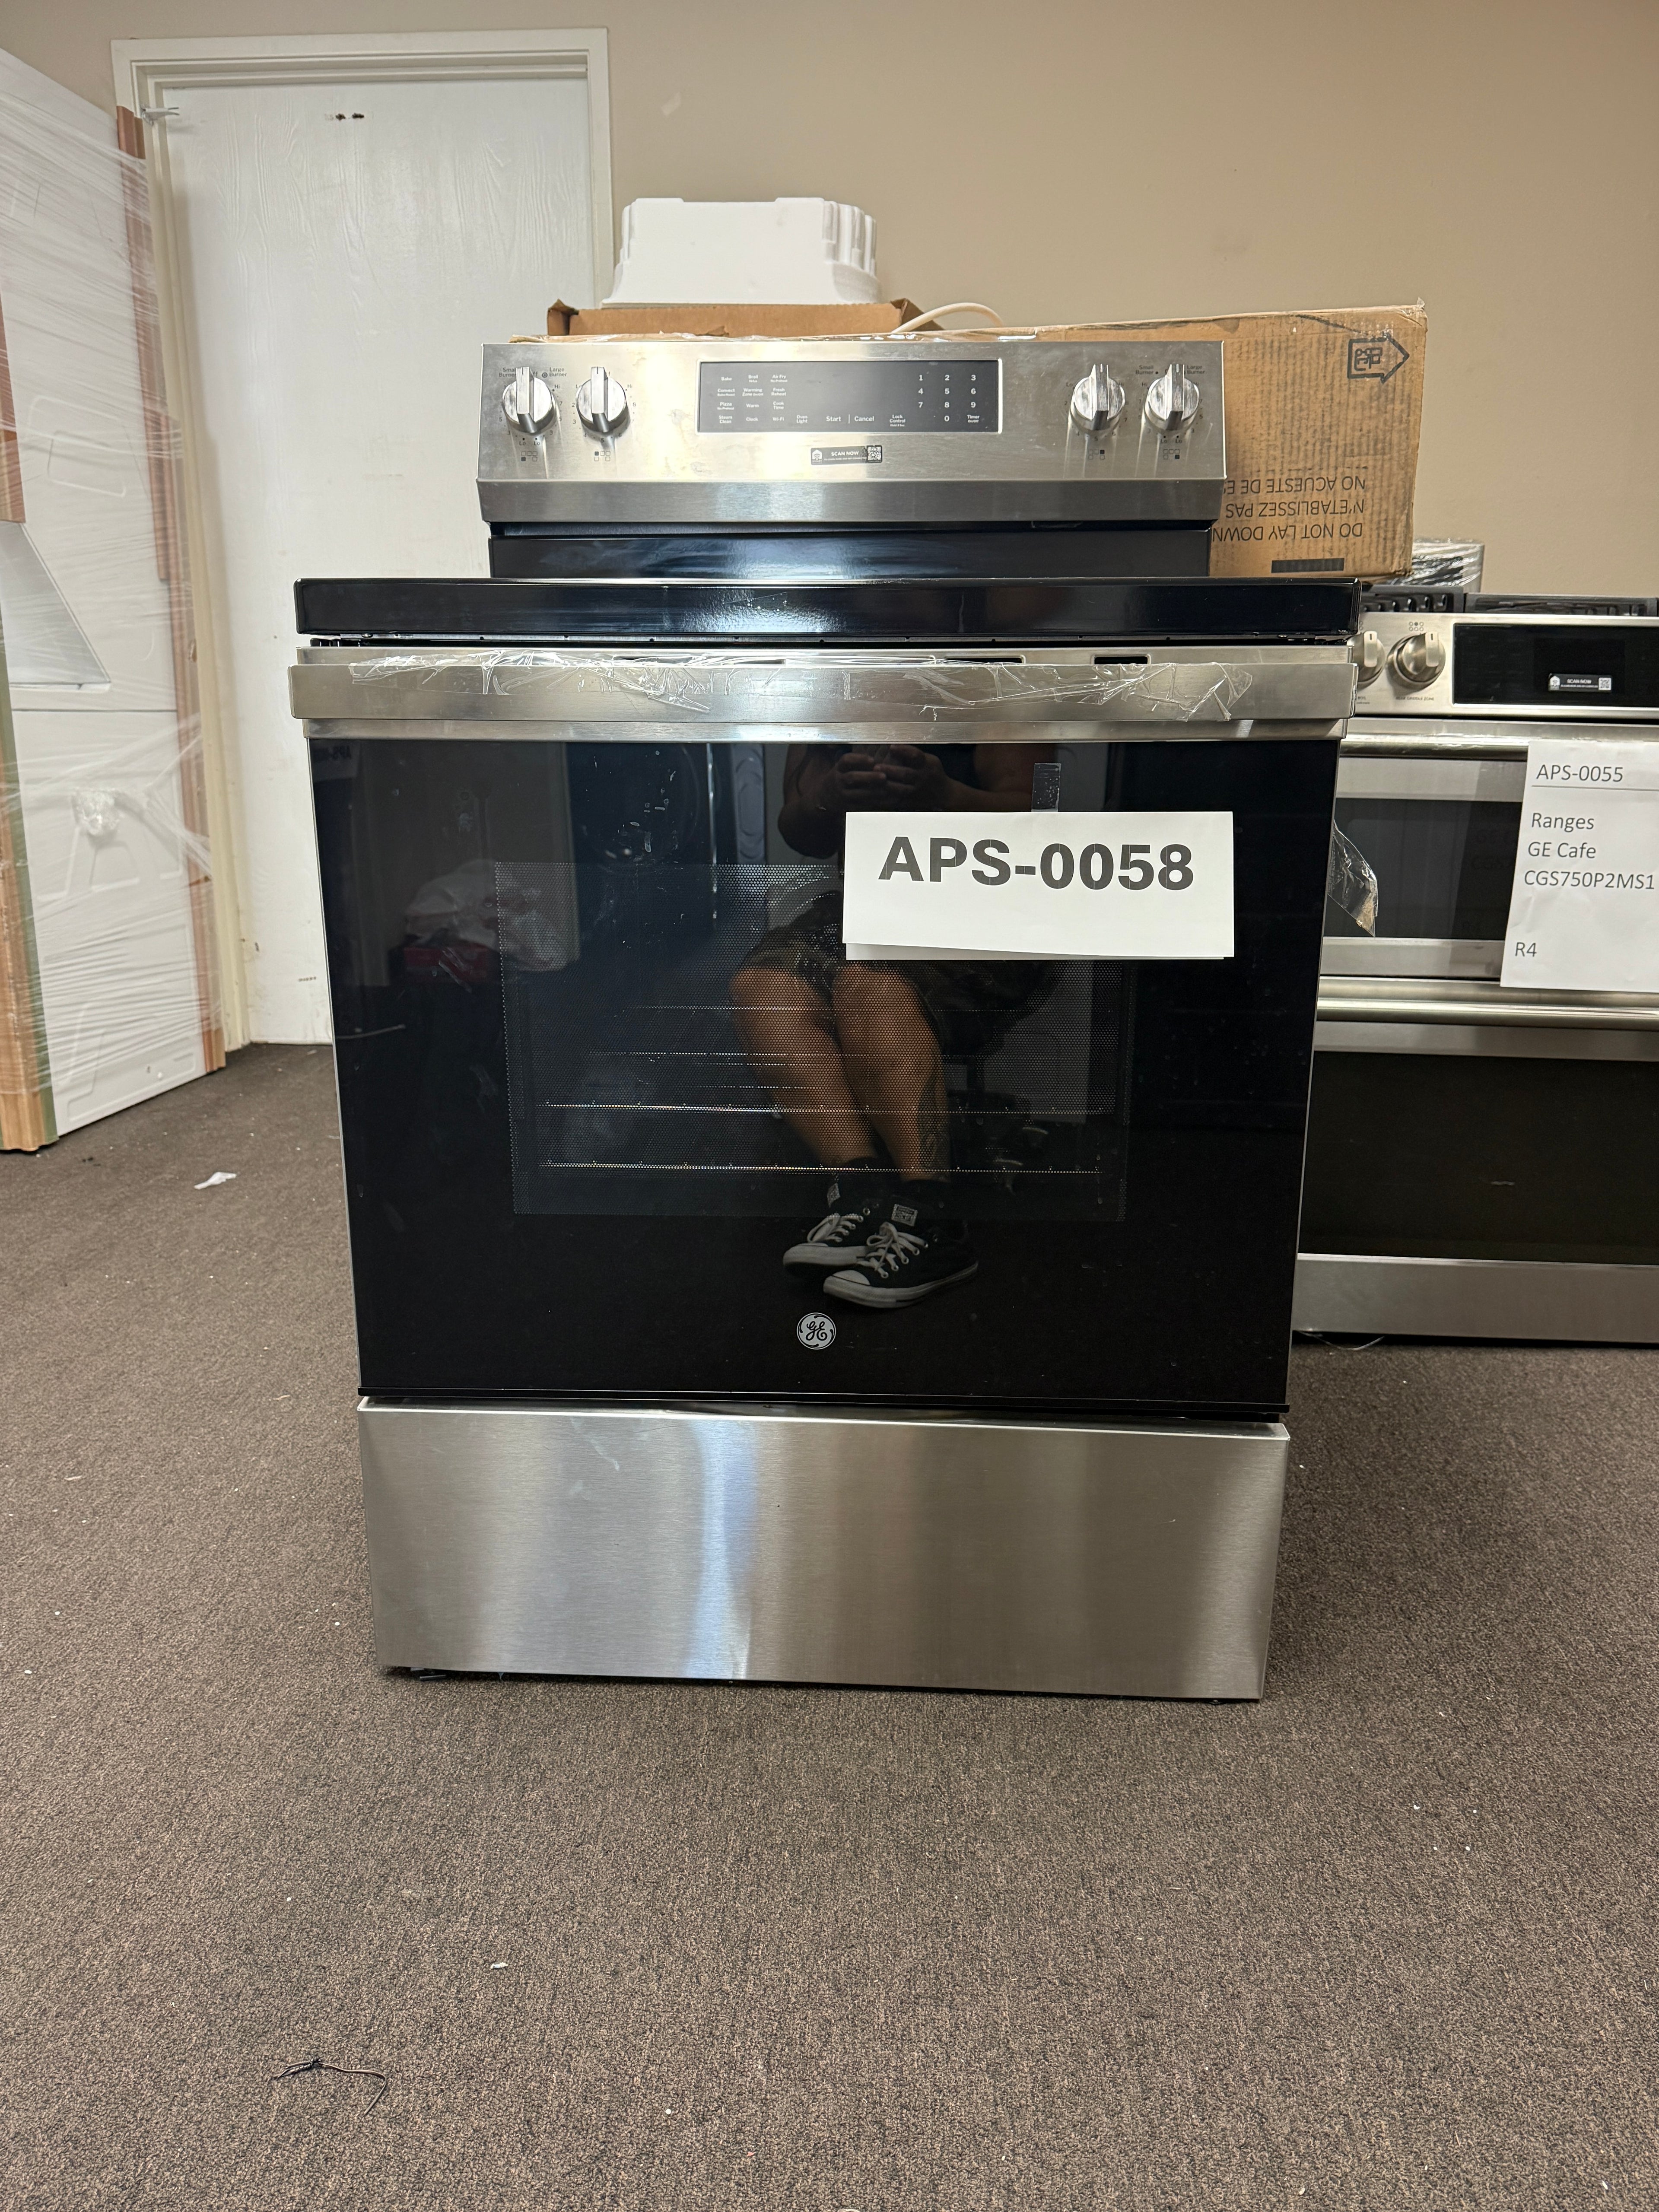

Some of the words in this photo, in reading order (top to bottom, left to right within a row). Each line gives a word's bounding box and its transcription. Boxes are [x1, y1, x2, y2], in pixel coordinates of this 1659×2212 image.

[1240, 479, 1261, 494] DE
[1266, 476, 1338, 493] ACUESTE
[1341, 475, 1366, 490] NO
[1226, 502, 1253, 518] PAS
[1258, 499, 1364, 517] N'ETABLISSEZ
[1212, 526, 1263, 542] DOWN
[1268, 525, 1296, 540] LAY
[1301, 523, 1334, 539] NOT
[1340, 522, 1363, 537] DO
[1536, 764, 1624, 782] APS-0055
[1531, 812, 1595, 833] Ranges
[1528, 841, 1552, 857] GE
[1557, 842, 1596, 858] Cafe
[878, 836, 1194, 890] APS-0058
[1524, 870, 1655, 890] CGS750P2MS1
[1514, 941, 1537, 957] R4
